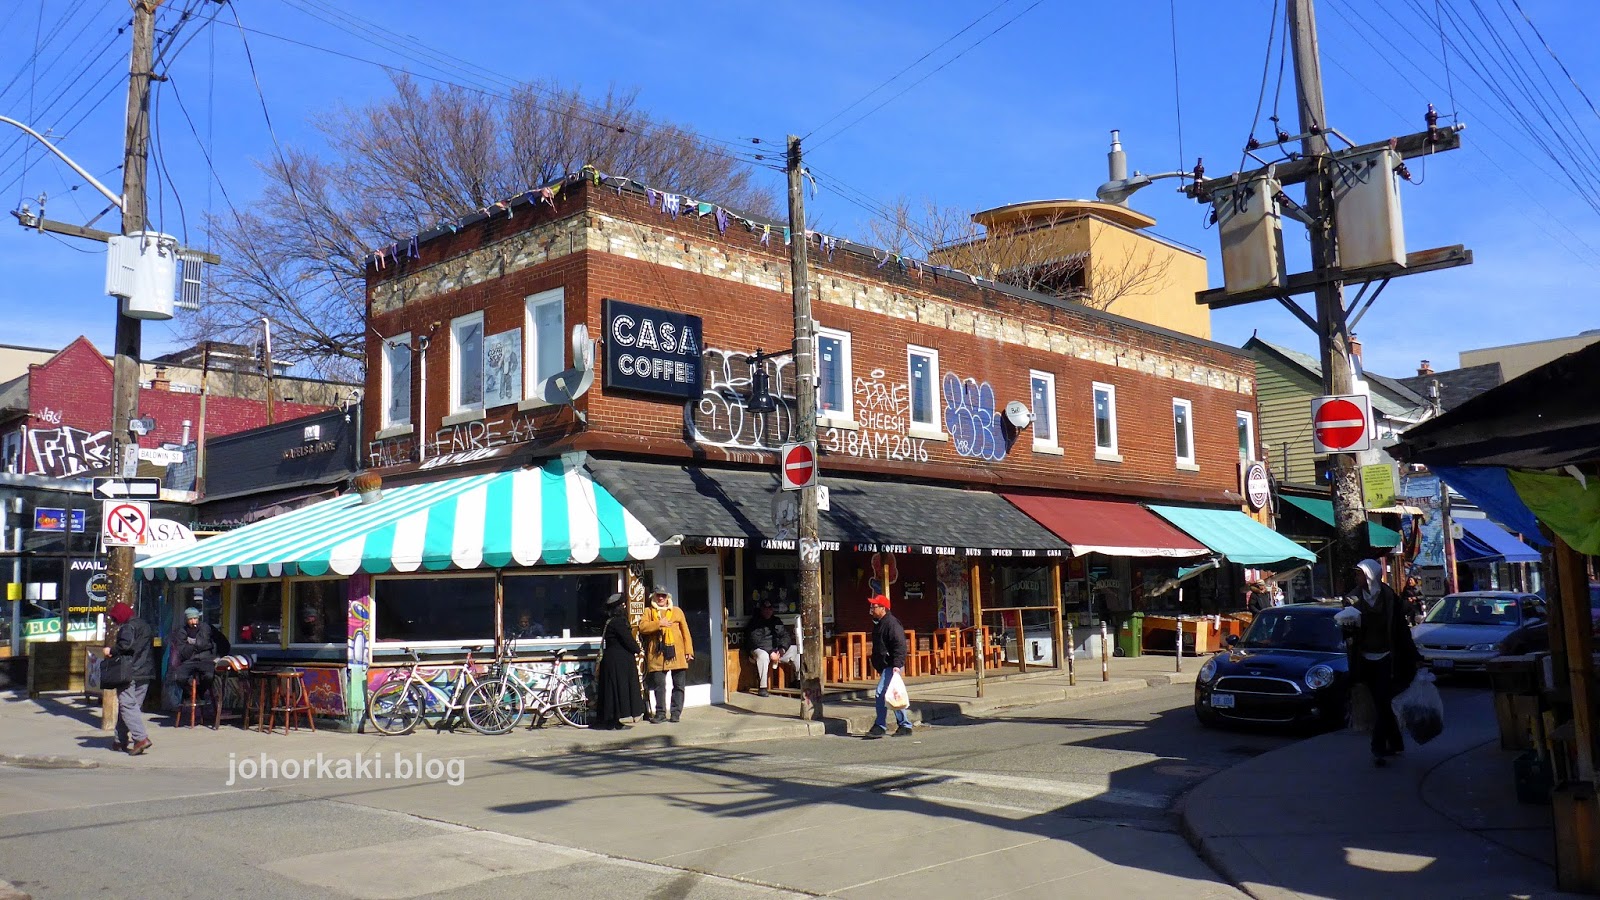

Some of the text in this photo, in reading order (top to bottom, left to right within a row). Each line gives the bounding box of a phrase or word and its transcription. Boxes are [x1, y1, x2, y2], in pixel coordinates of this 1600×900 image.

[612, 314, 700, 357] CASA
[618, 353, 695, 384] COFFEE
[859, 408, 905, 435] SHEESH
[140, 450, 180, 461] BALDWIN ST
[705, 536, 745, 548] CANDIES
[760, 539, 796, 550] CANNOLI
[858, 543, 878, 553] CASA
[881, 544, 908, 554] COFFEE
[921, 545, 933, 555] ICE
[935, 546, 956, 556] CREAM
[965, 547, 982, 556] NUTS
[991, 549, 1013, 557] SPICES
[1022, 549, 1036, 557] TEAS
[1046, 549, 1062, 557] CASA
